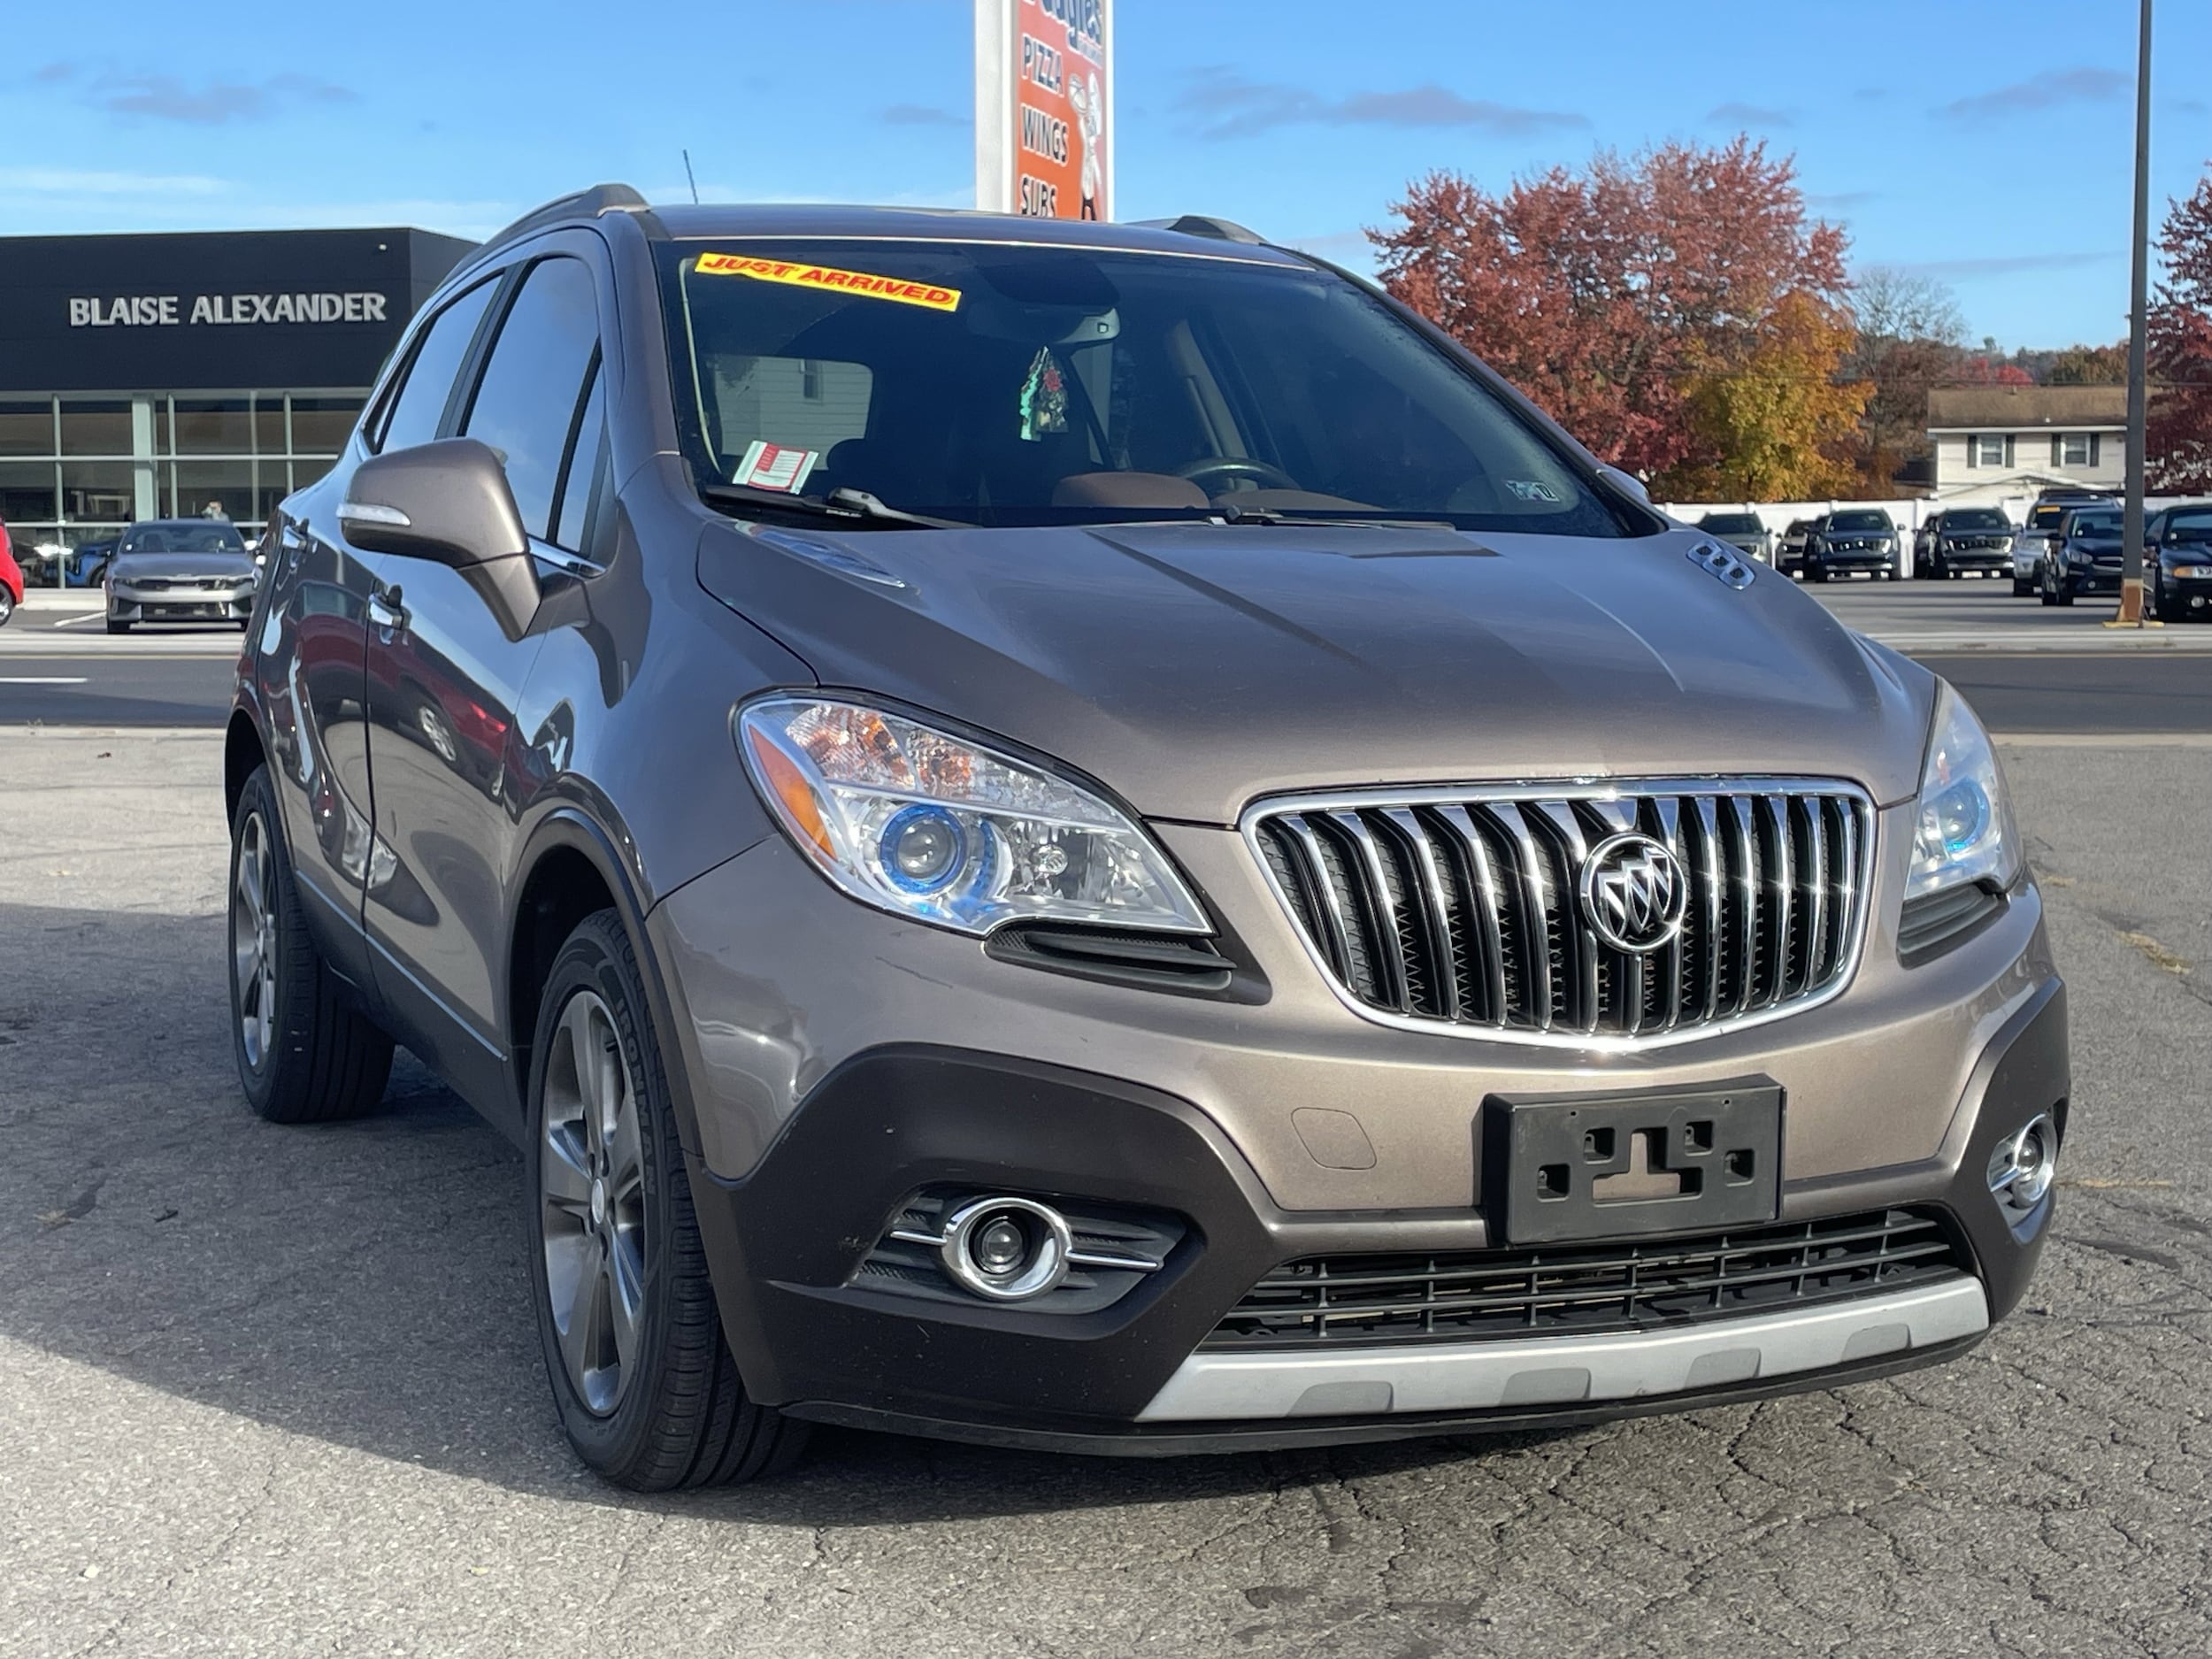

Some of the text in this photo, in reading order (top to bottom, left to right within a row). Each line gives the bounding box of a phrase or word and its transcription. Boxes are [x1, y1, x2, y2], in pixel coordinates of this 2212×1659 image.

[1022, 34, 1065, 96] PIZZA
[1022, 104, 1068, 165] WINGS
[1021, 174, 1057, 217] SUBS
[703, 257, 955, 304] JUST ARRIVED
[70, 293, 386, 326] BLAISE ALEXANDER
[616, 995, 657, 1197] IRONMAN
